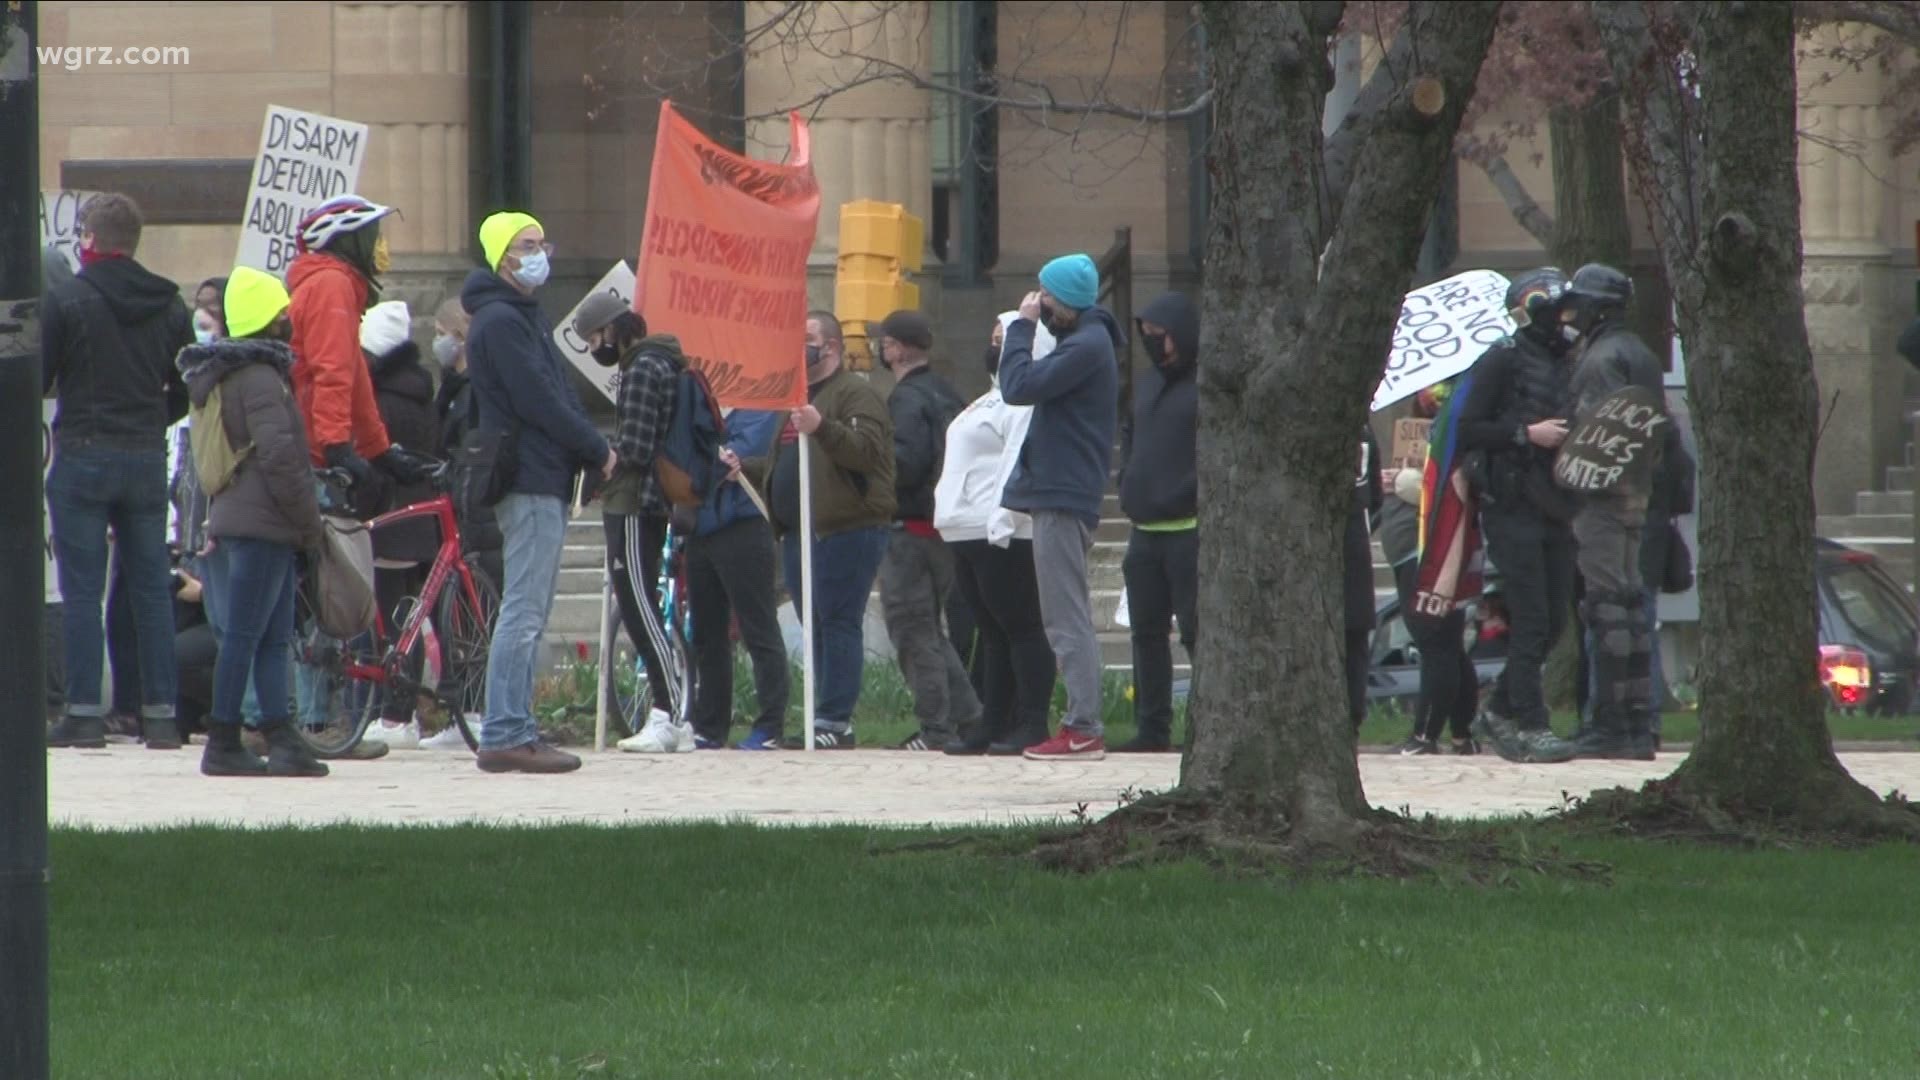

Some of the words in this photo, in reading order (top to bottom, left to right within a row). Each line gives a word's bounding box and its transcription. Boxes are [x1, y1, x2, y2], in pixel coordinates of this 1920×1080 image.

[266, 113, 359, 165] DISARM
[258, 154, 347, 199] DEFUND
[247, 196, 312, 241] ABOLI
[1402, 294, 1462, 358] GOOD
[1431, 281, 1480, 312] ARE
[1457, 308, 1508, 345] NO
[1595, 397, 1667, 438] BLACK
[1574, 425, 1643, 463] LIVES
[1555, 453, 1624, 489] MATTER
